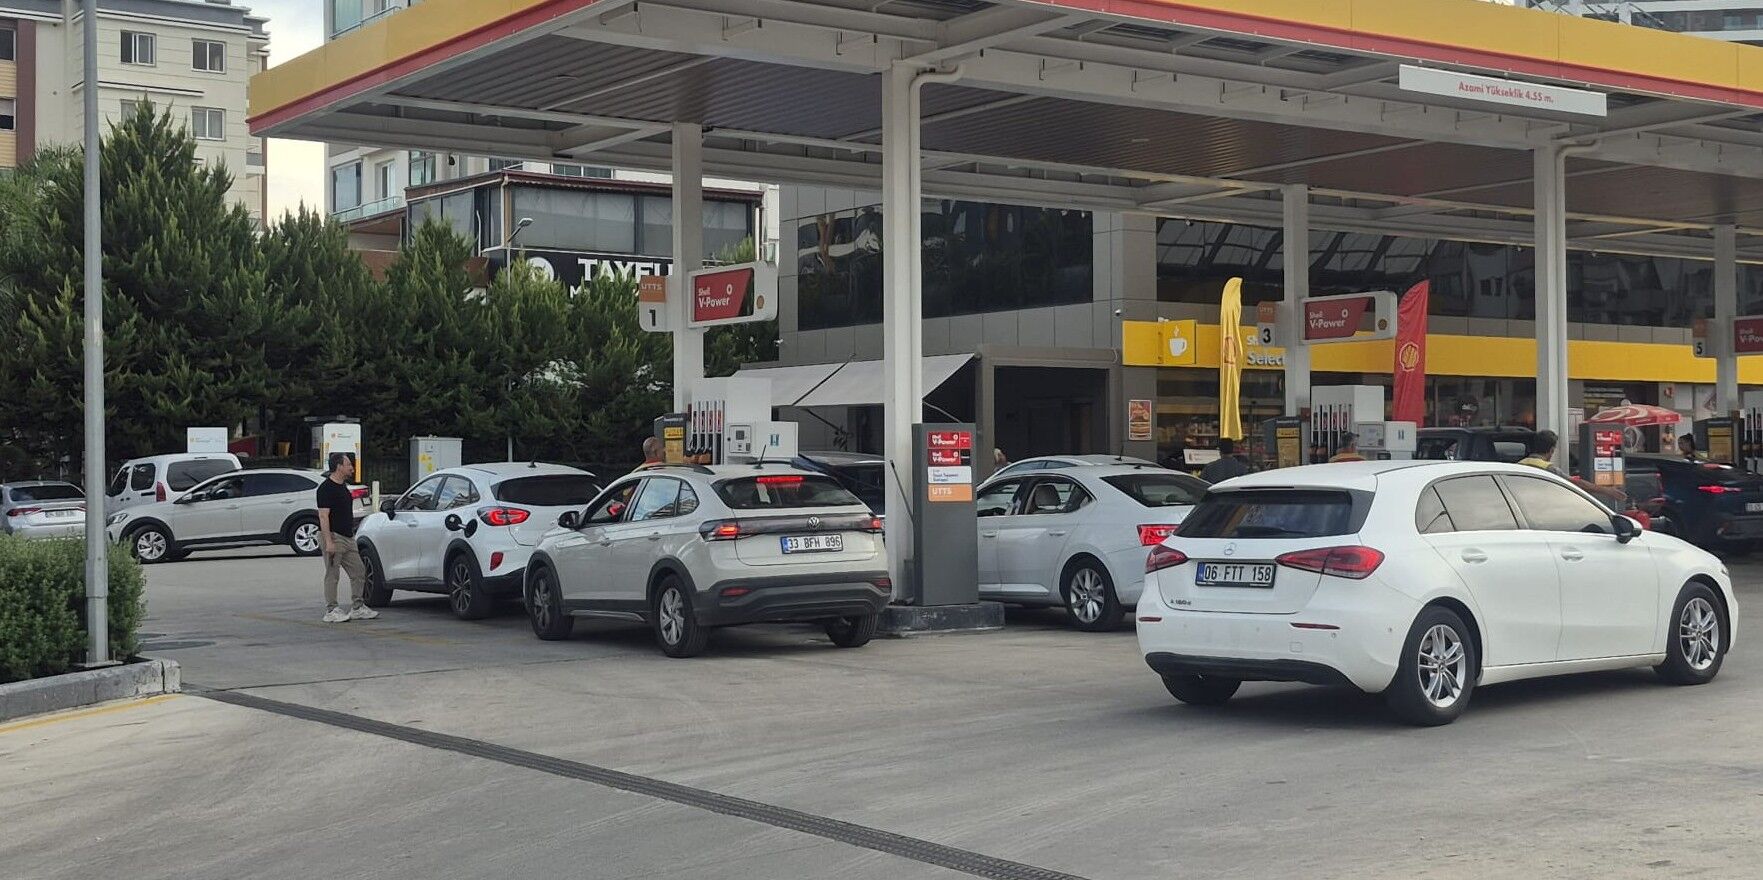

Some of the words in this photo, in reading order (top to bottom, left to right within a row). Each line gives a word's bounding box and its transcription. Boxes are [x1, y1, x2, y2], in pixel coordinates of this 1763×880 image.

[1458, 81, 1484, 94] Azami
[1485, 84, 1524, 99] Yükseklik
[1525, 90, 1543, 102] 4.55
[641, 283, 662, 291] UTTS
[698, 287, 711, 297] Shell
[698, 296, 730, 308] V-Power
[648, 309, 656, 327] 1
[1309, 311, 1323, 319] Shell
[1309, 318, 1346, 329] V-Power
[1262, 328, 1271, 344] 3
[1696, 342, 1703, 355] 5
[788, 538, 799, 549] 33
[804, 537, 820, 549] BFH
[825, 536, 841, 547] 896
[1204, 565, 1218, 581] 06
[1223, 565, 1245, 581] FTT
[1252, 566, 1272, 582] 158
